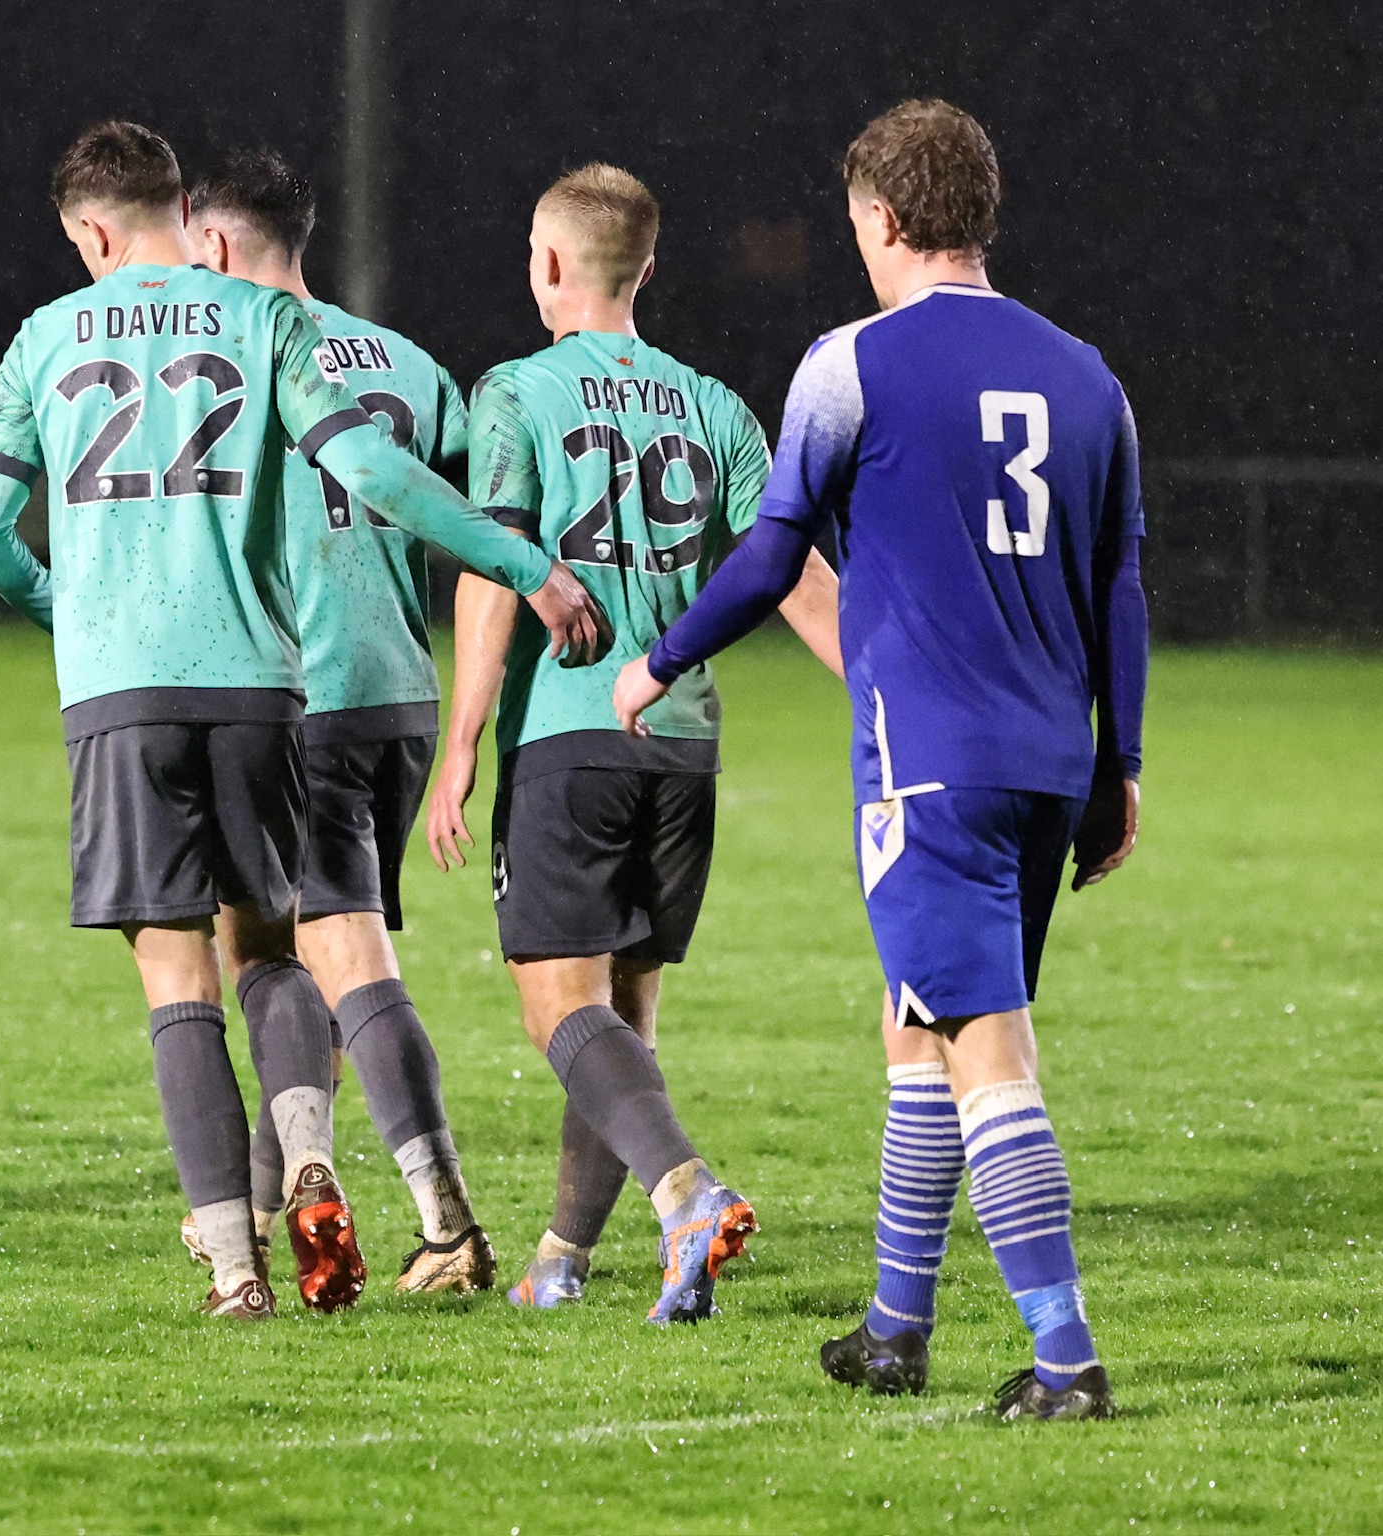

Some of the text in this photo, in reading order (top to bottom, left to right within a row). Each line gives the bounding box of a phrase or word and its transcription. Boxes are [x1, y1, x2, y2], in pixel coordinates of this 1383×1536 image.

[76, 302, 223, 344] D DAVIES
[54, 350, 247, 508] 22
[558, 422, 718, 576] 29
[979, 390, 1049, 557] 3
